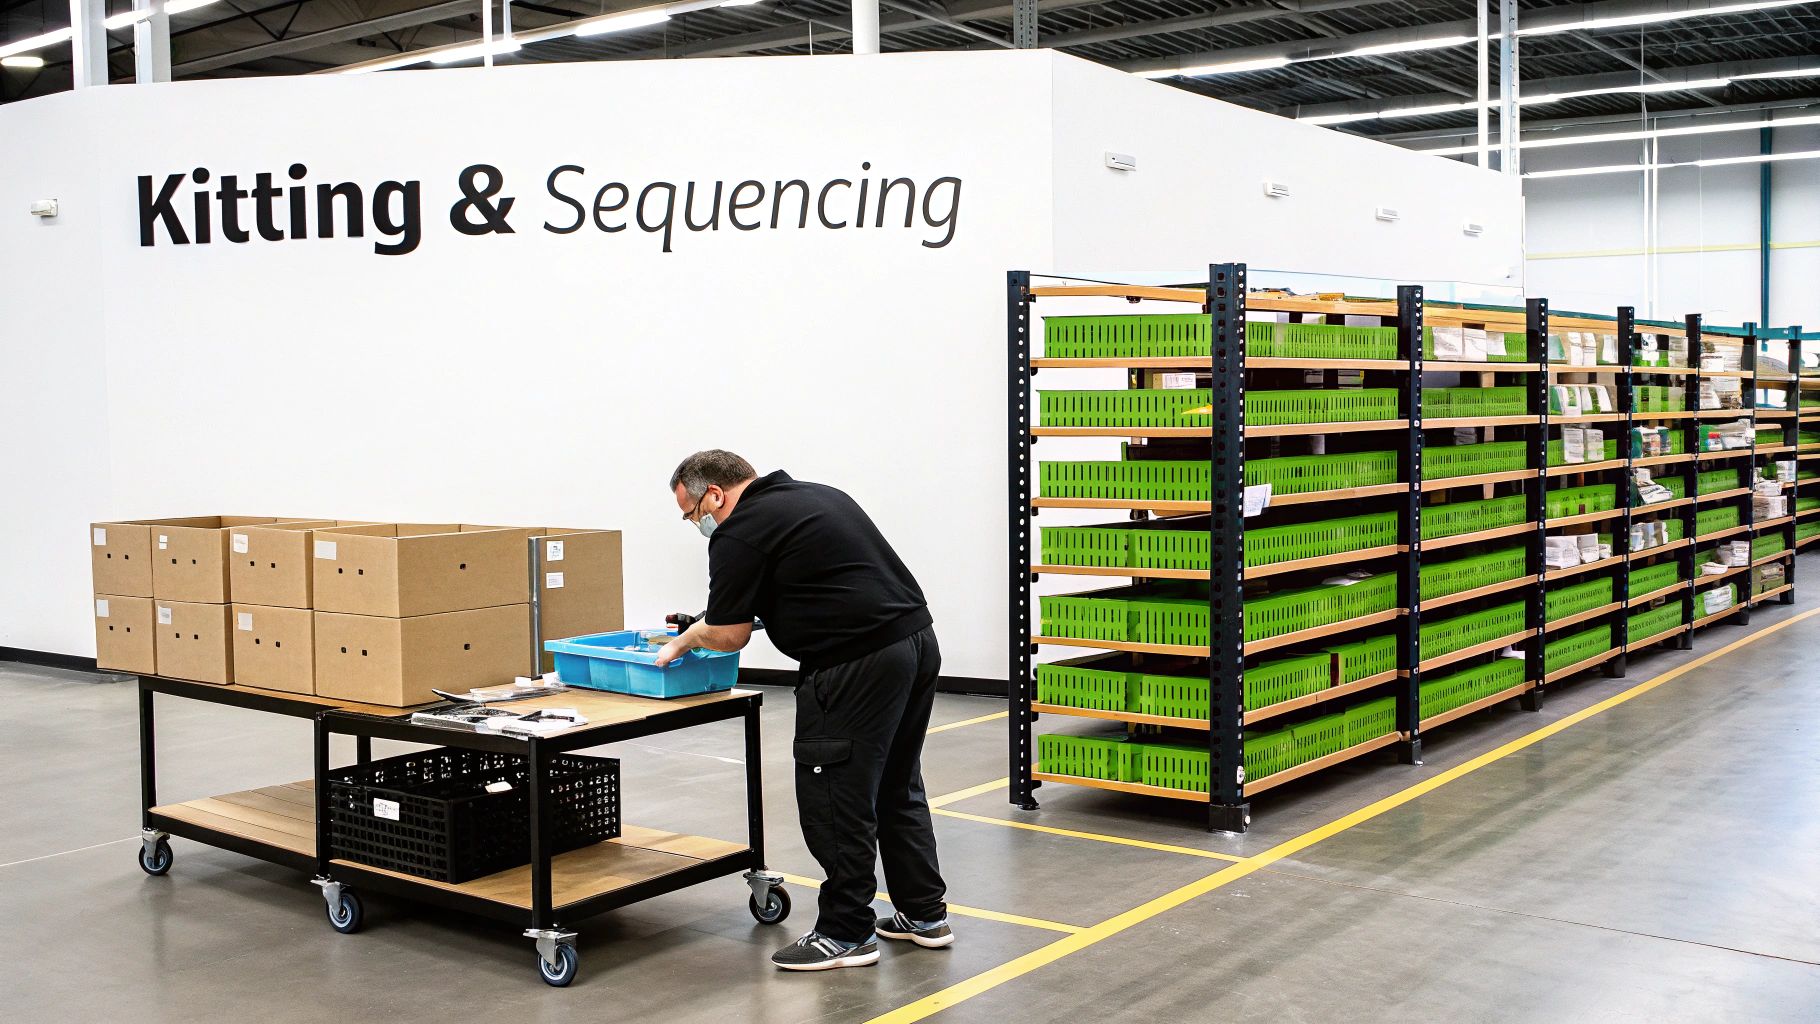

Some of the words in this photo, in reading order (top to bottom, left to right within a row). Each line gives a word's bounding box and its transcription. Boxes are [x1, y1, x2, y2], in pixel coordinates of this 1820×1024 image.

[138, 163, 421, 255] Kitting
[450, 164, 515, 235] &
[544, 162, 963, 252] Sequencing
